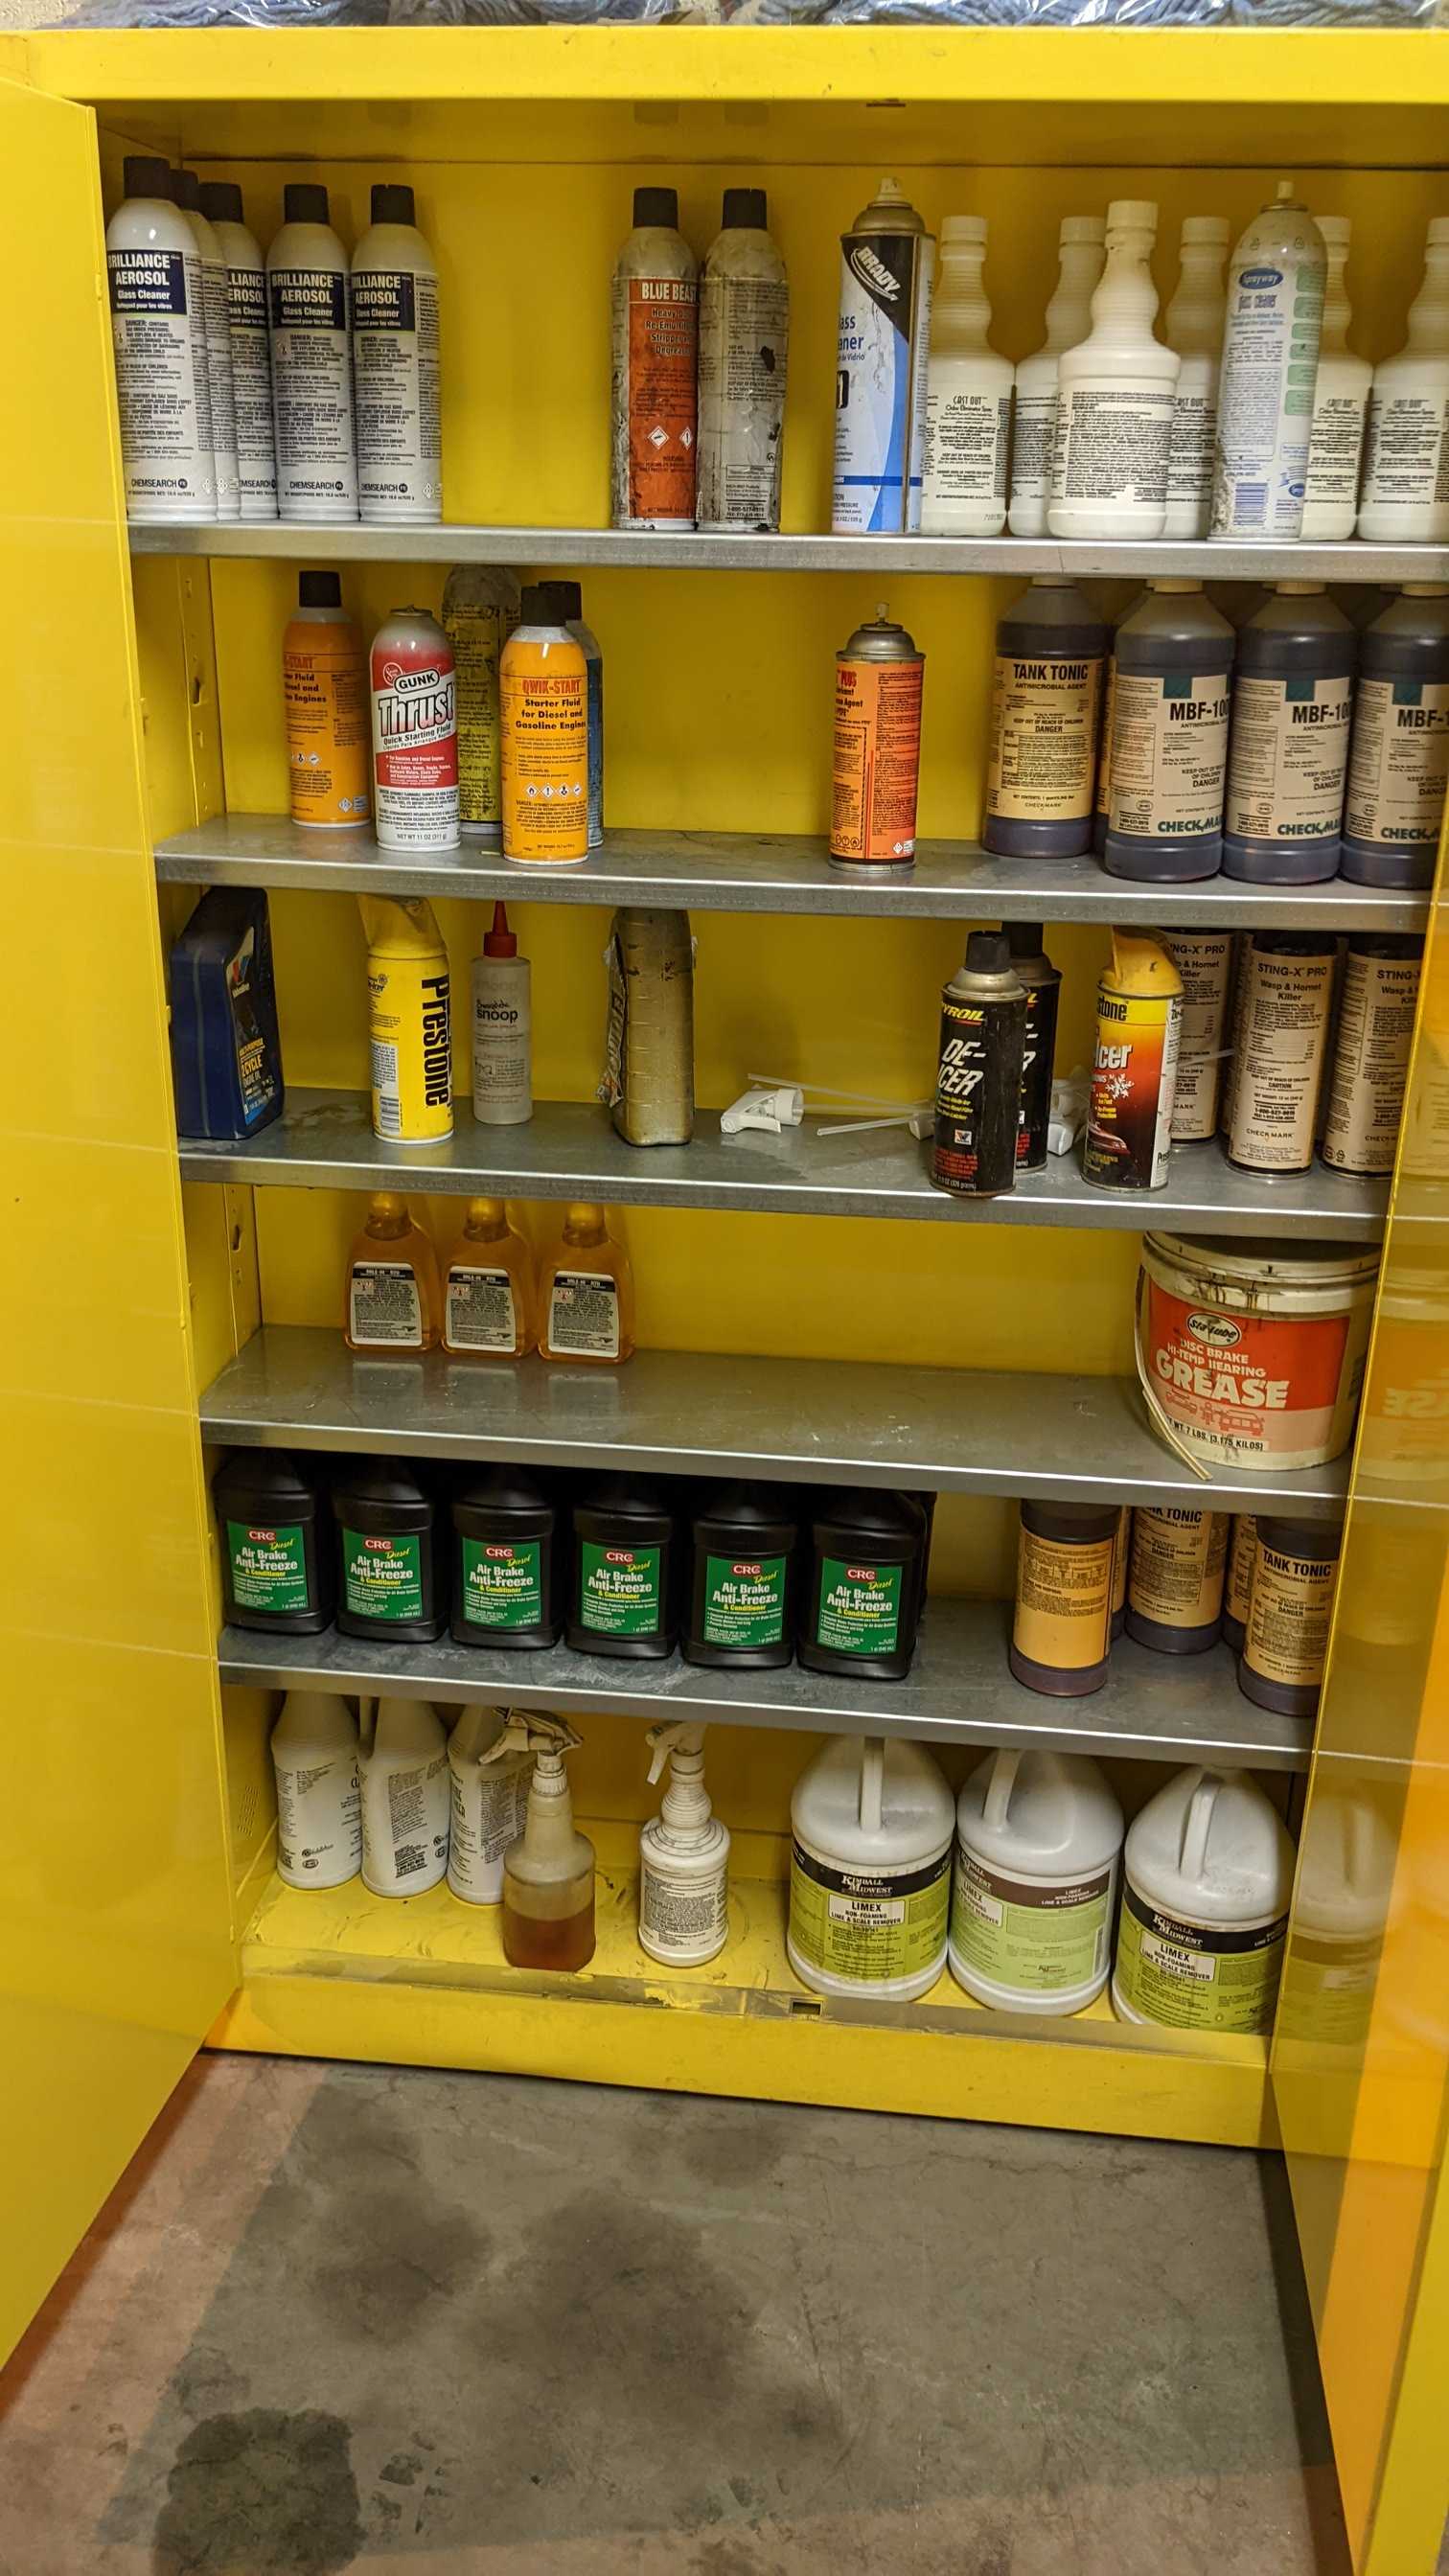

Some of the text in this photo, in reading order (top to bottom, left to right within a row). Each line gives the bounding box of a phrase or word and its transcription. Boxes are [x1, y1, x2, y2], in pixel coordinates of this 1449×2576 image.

[108, 253, 171, 268] BRILLIANCE
[116, 270, 170, 286] AEROSOL
[272, 274, 334, 288] BRILLIANCE
[118, 289, 171, 300] Glass Cleaner
[228, 289, 265, 303] EROSOL
[281, 290, 333, 304] AEROSOL
[356, 291, 400, 304] AEROSOL
[642, 282, 669, 300] BLUE
[283, 308, 334, 317] Glass Cleaner
[371, 310, 400, 318] Cleaner
[131, 479, 177, 488] CHEMSEARCH
[289, 481, 334, 491] CHEMSEARCH
[294, 673, 314, 681] Fluid
[1013, 663, 1089, 680] TANK TONIC
[399, 672, 436, 689] GUNK
[521, 679, 581, 695] QWIK-START
[295, 694, 327, 703] Engines
[525, 698, 581, 707] Starter Fluid
[844, 700, 862, 709] Agent
[379, 681, 453, 737] Thrust
[521, 710, 536, 719] for
[569, 708, 583, 717] and
[1292, 702, 1351, 724] MBF-10
[516, 721, 557, 730] Gasoline
[383, 724, 451, 745] Quick Starting Fluid
[1192, 776, 1220, 787] DANGER
[1205, 944, 1226, 954] PRO
[1192, 960, 1220, 969] Hornet
[1257, 963, 1327, 977] STING-X PRO
[1260, 979, 1282, 991] Wasp
[1381, 986, 1405, 996] Wasp
[1277, 992, 1302, 1000] Killer
[476, 1007, 518, 1024] snoop
[421, 973, 454, 1109] Prestone
[941, 1038, 987, 1067] DE-
[938, 1064, 984, 1096] ICER
[1180, 1338, 1249, 1365] DISC BRAKE
[1167, 1343, 1267, 1378] HI-TEMP BEARING
[1156, 1348, 1290, 1410] GREASE
[1174, 1420, 1184, 1433] WT
[1185, 1426, 1191, 1436] 7
[1235, 1439, 1265, 1452] KILOS)
[1166, 1507, 1203, 1524] TONIC
[249, 1530, 275, 1541] CRC
[269, 1537, 295, 1551] Diesel
[365, 1540, 392, 1551] CRC
[242, 1547, 288, 1561] Air Brake
[385, 1547, 411, 1560] Diesel
[486, 1548, 513, 1558] CRC
[606, 1552, 633, 1563] CRC
[236, 1554, 298, 1571] Anti-Freeze
[356, 1555, 403, 1570] Air Brake
[506, 1553, 532, 1568] Diesel
[627, 1559, 652, 1573] Diesel
[1262, 1548, 1331, 1576] TANK TONIC
[350, 1563, 414, 1579] Anti-Freeze
[476, 1563, 524, 1577] Air Brake
[595, 1568, 644, 1582] Air Brake
[733, 1564, 761, 1576] CRC
[753, 1570, 778, 1584] Diesel
[847, 1569, 876, 1580] CRC
[365, 1578, 402, 1587] Conditioner
[470, 1572, 534, 1587] Anti-Freeze
[587, 1576, 653, 1594] Anti-Freeze
[867, 1577, 893, 1591] Diesel
[722, 1582, 770, 1595] Air Brake
[836, 1585, 885, 1600] Air Brake
[712, 1590, 778, 1605] Anti-Freeze
[826, 1594, 893, 1612] Anti-Freeze
[843, 1609, 881, 1619] Conditioner
[1277, 1606, 1303, 1617] DANGER
[841, 1874, 884, 1886] KIMBALL
[848, 1883, 893, 1894] MIDWEST
[851, 1900, 882, 1912] LIMEX
[831, 1912, 845, 1921] LIME
[1153, 1914, 1194, 1935] KIMBALL
[1159, 1924, 1204, 1946] MIDWEST
[1160, 1944, 1190, 1962] LIMEX
[1161, 1959, 1180, 1973] SCALE
[1182, 1965, 1210, 1981] REMOVER
